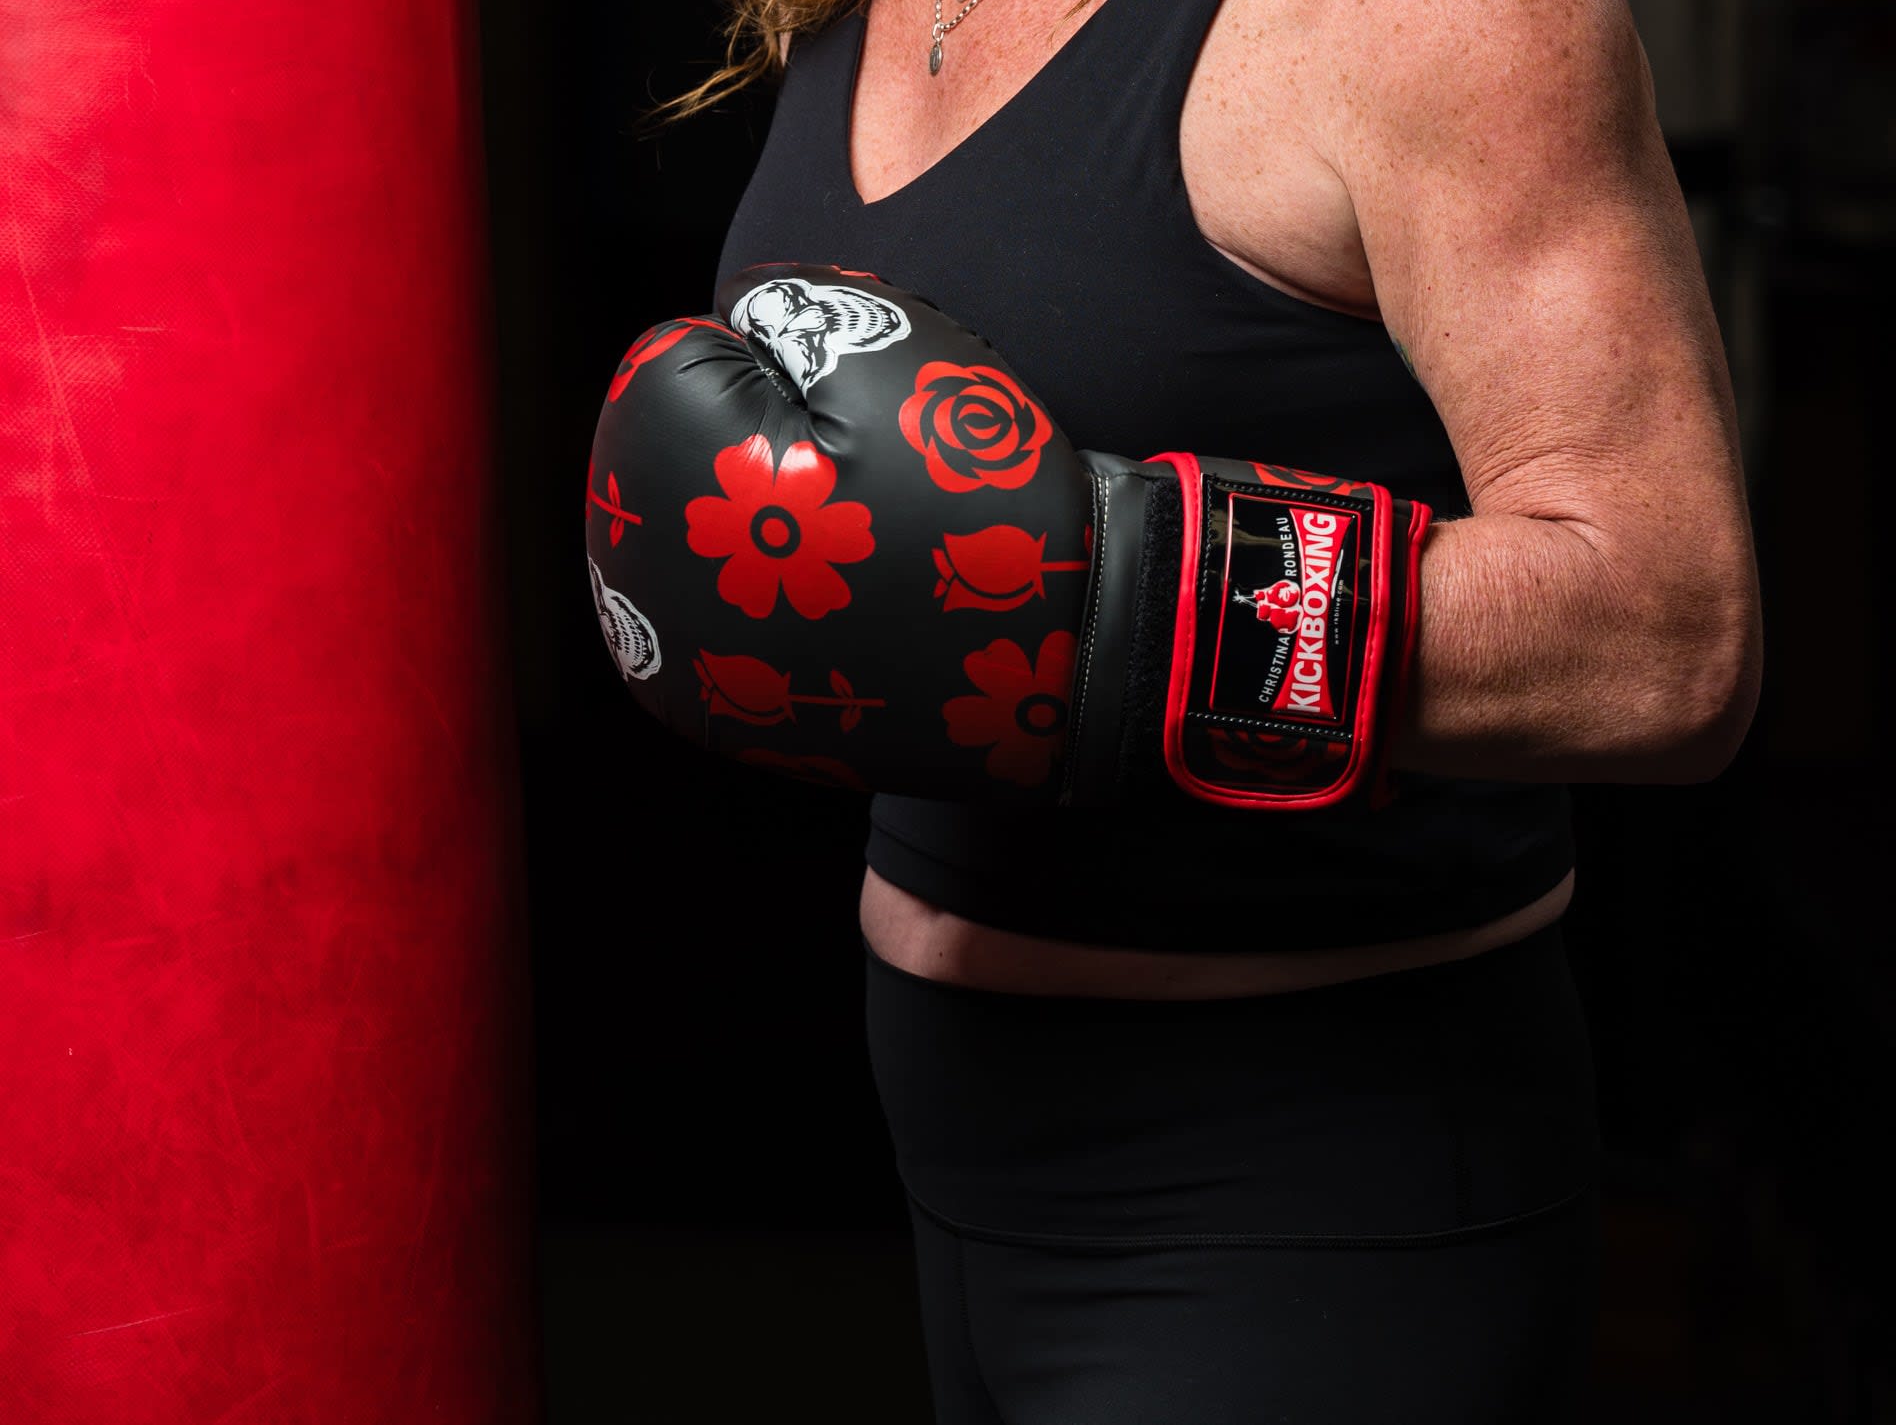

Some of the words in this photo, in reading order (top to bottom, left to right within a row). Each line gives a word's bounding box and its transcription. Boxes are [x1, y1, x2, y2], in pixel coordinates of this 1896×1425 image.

[1259, 635, 1290, 703] CHRISTINA
[1276, 517, 1297, 576] RONDEAU
[1287, 512, 1337, 713] KICKBOXING
